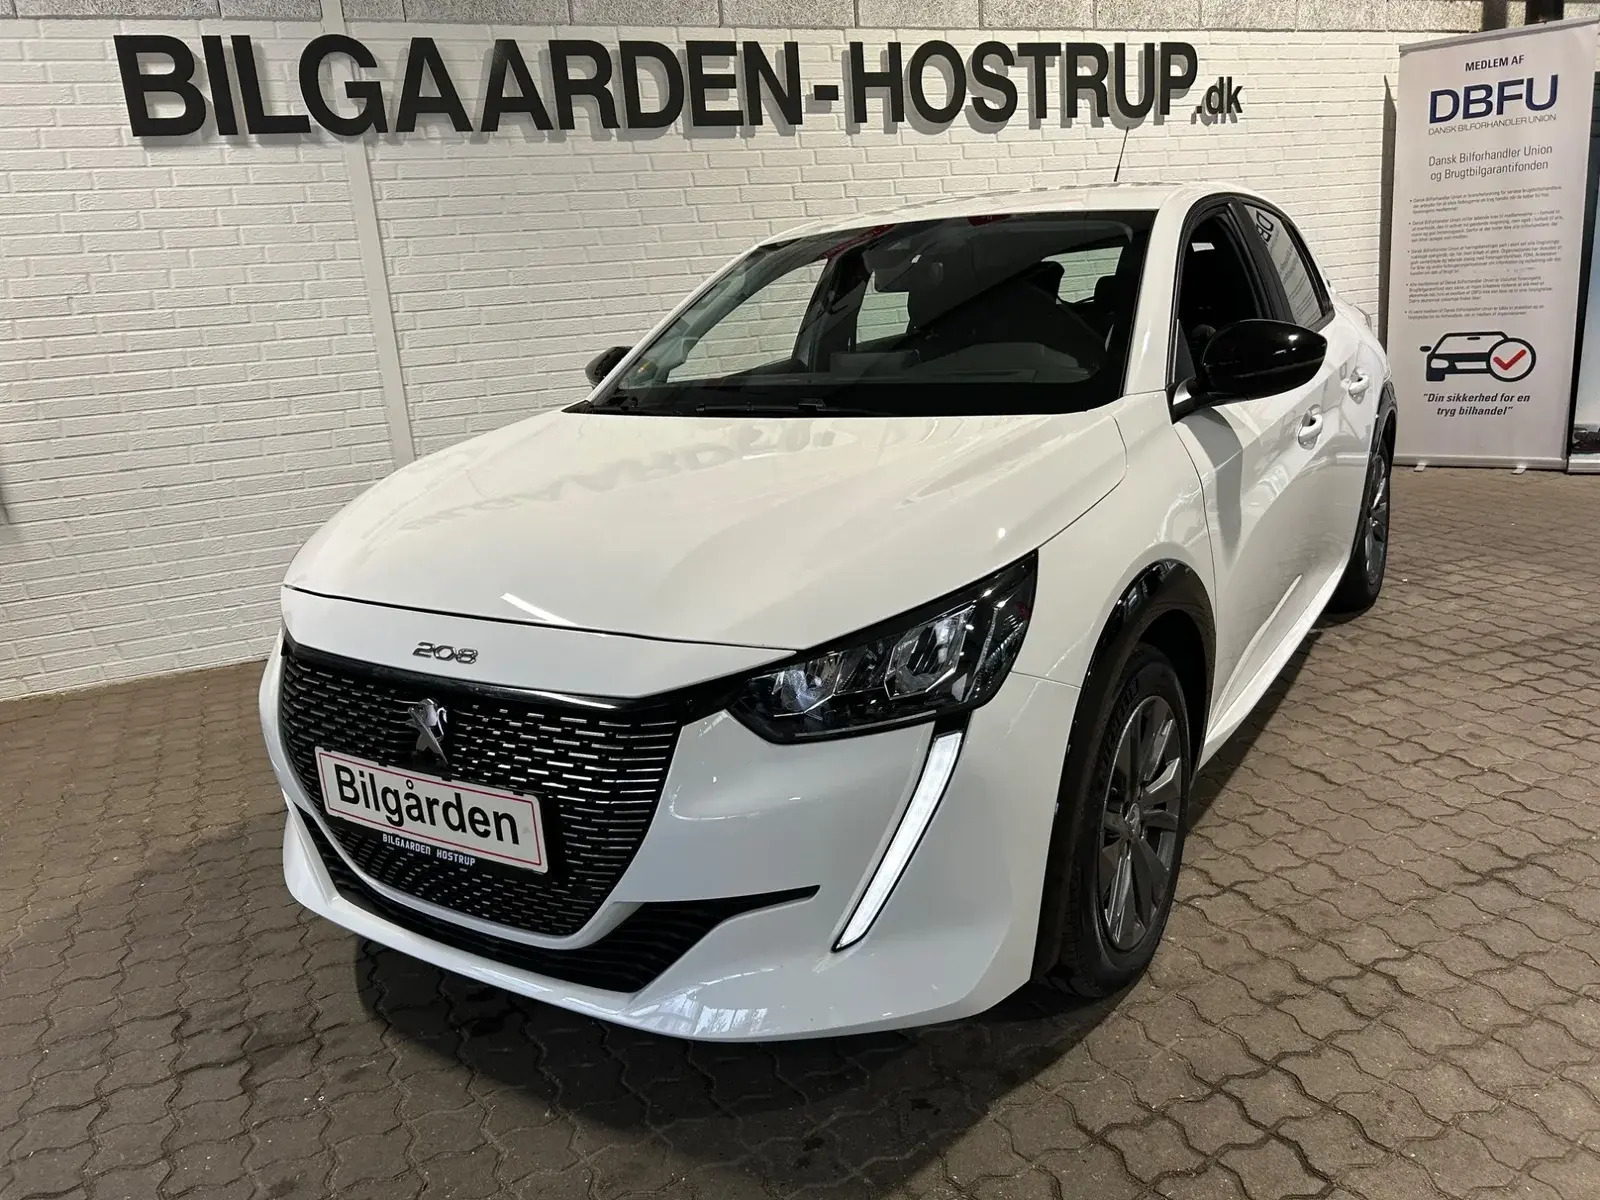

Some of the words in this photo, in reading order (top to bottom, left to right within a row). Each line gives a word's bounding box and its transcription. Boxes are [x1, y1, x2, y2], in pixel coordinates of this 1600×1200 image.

[1465, 57, 1509, 72] MEDLEM
[1511, 54, 1525, 65] AF
[1429, 74, 1559, 124] DBFU
[1428, 124, 1460, 136] DANSK
[1457, 117, 1527, 132] BILFORHANDLER
[1528, 114, 1557, 125] UNION
[1428, 154, 1457, 167] Dansk
[1459, 148, 1521, 164] Bilforhandler
[1523, 144, 1553, 157] Union
[1430, 171, 1442, 182] og
[1444, 160, 1549, 180] Brugtbilgarantifonden
[1446, 392, 1499, 403] sikkerhed
[1500, 392, 1515, 403] for
[1516, 395, 1531, 403] en
[1436, 406, 1457, 417] tryg
[412, 641, 478, 665] 208
[334, 764, 521, 845] Bilgården
[382, 833, 432, 855] BILGAARDEN
[436, 848, 476, 867] HOSTRUP
